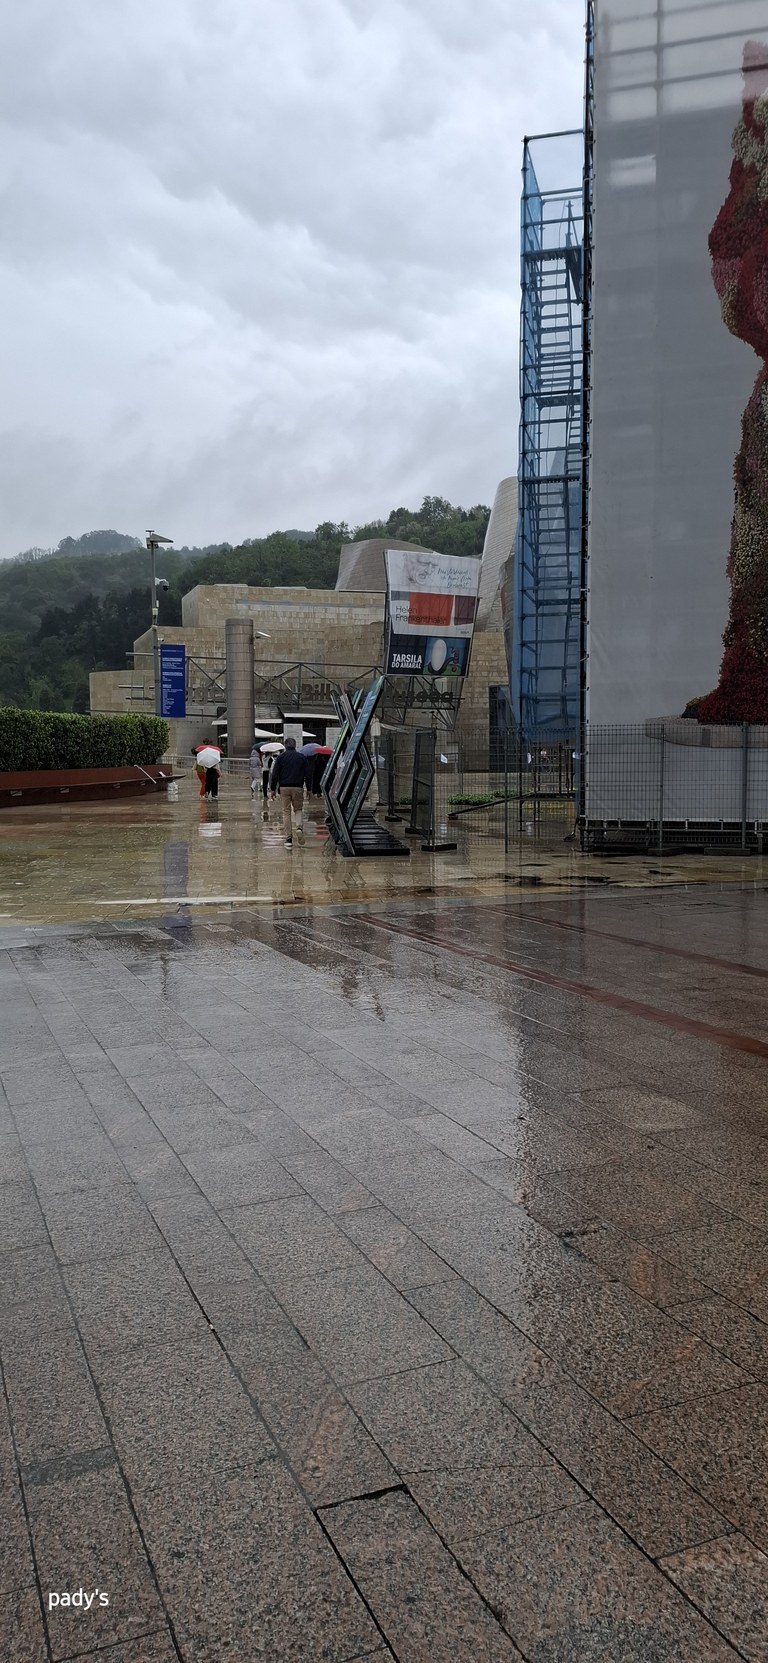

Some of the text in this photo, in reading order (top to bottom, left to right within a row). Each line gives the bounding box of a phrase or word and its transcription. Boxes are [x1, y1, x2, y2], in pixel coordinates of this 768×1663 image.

[395, 604, 418, 614] Helen
[392, 653, 423, 664] TARSILA
[391, 661, 400, 669] DO
